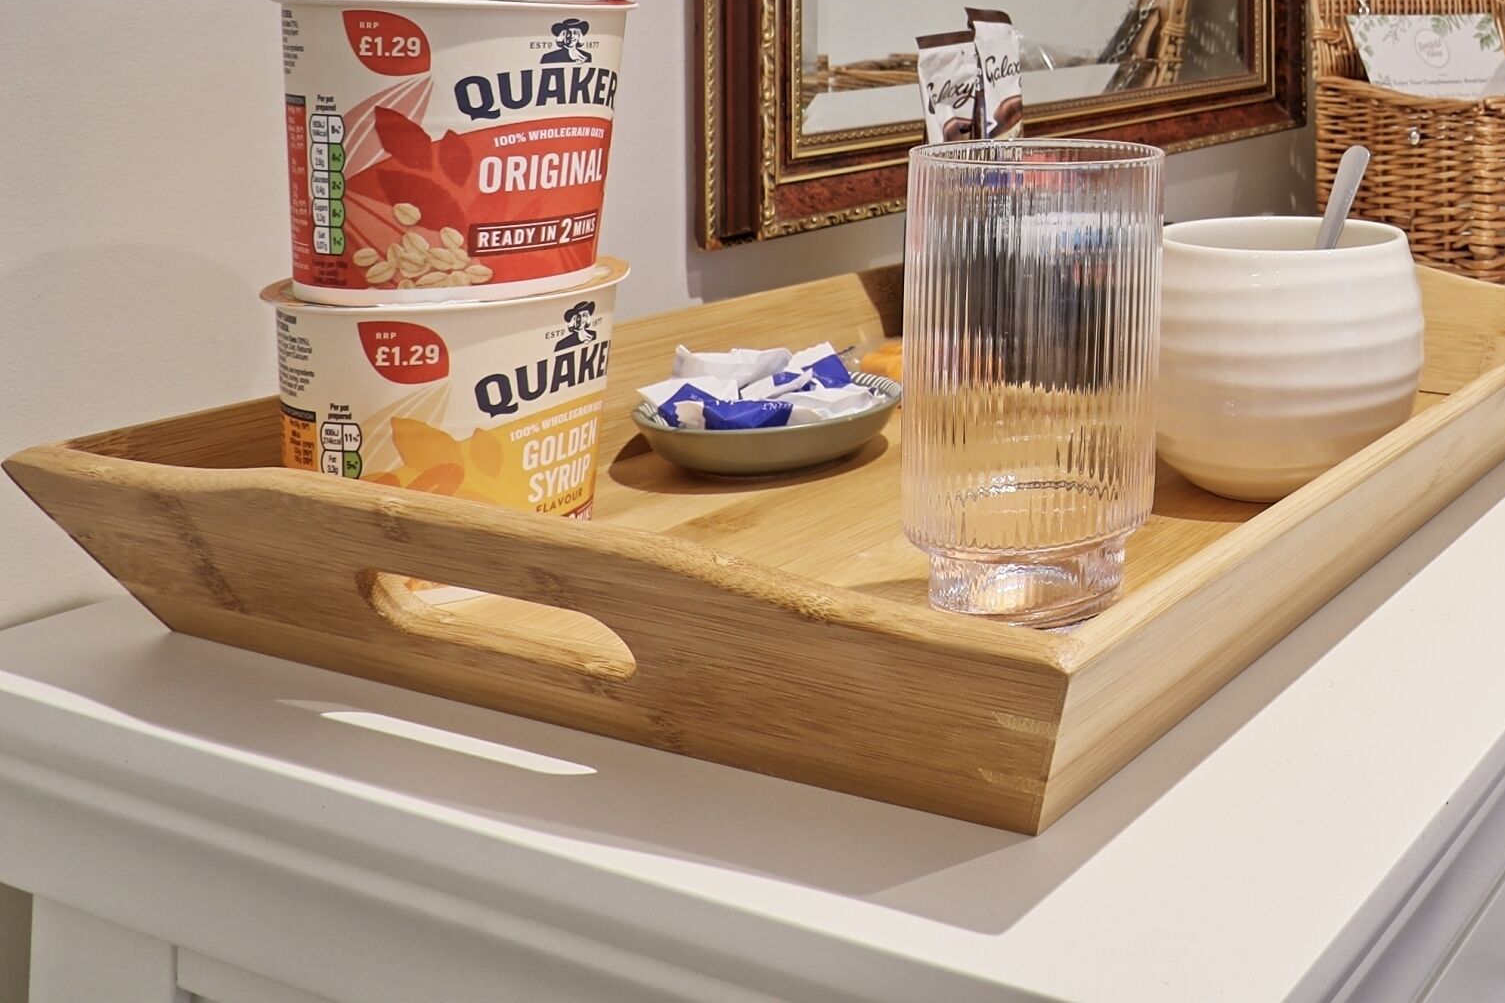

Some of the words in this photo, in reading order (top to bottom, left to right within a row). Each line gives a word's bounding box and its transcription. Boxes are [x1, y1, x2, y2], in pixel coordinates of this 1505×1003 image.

[359, 21, 380, 29] RRP
[359, 36, 421, 58] £1.29
[586, 41, 600, 49] 1877
[985, 55, 1022, 88] Galax
[454, 66, 618, 121] QUAKER
[926, 80, 976, 114] Galaxy
[494, 132, 527, 148] 100%
[528, 126, 591, 142] WHOLEGRAIN
[478, 147, 603, 194] ORIGINAL
[477, 227, 536, 249] READY
[540, 224, 557, 243] IN
[558, 217, 572, 244] 2
[572, 217, 596, 237] MINS
[375, 332, 397, 340] RRP
[375, 344, 440, 367] £1.29
[474, 339, 611, 418] QUAKE
[510, 422, 541, 442] 100%
[522, 416, 598, 471] GOLDEN
[528, 452, 592, 504] SYRUP
[535, 487, 583, 514] FLAVOUR
